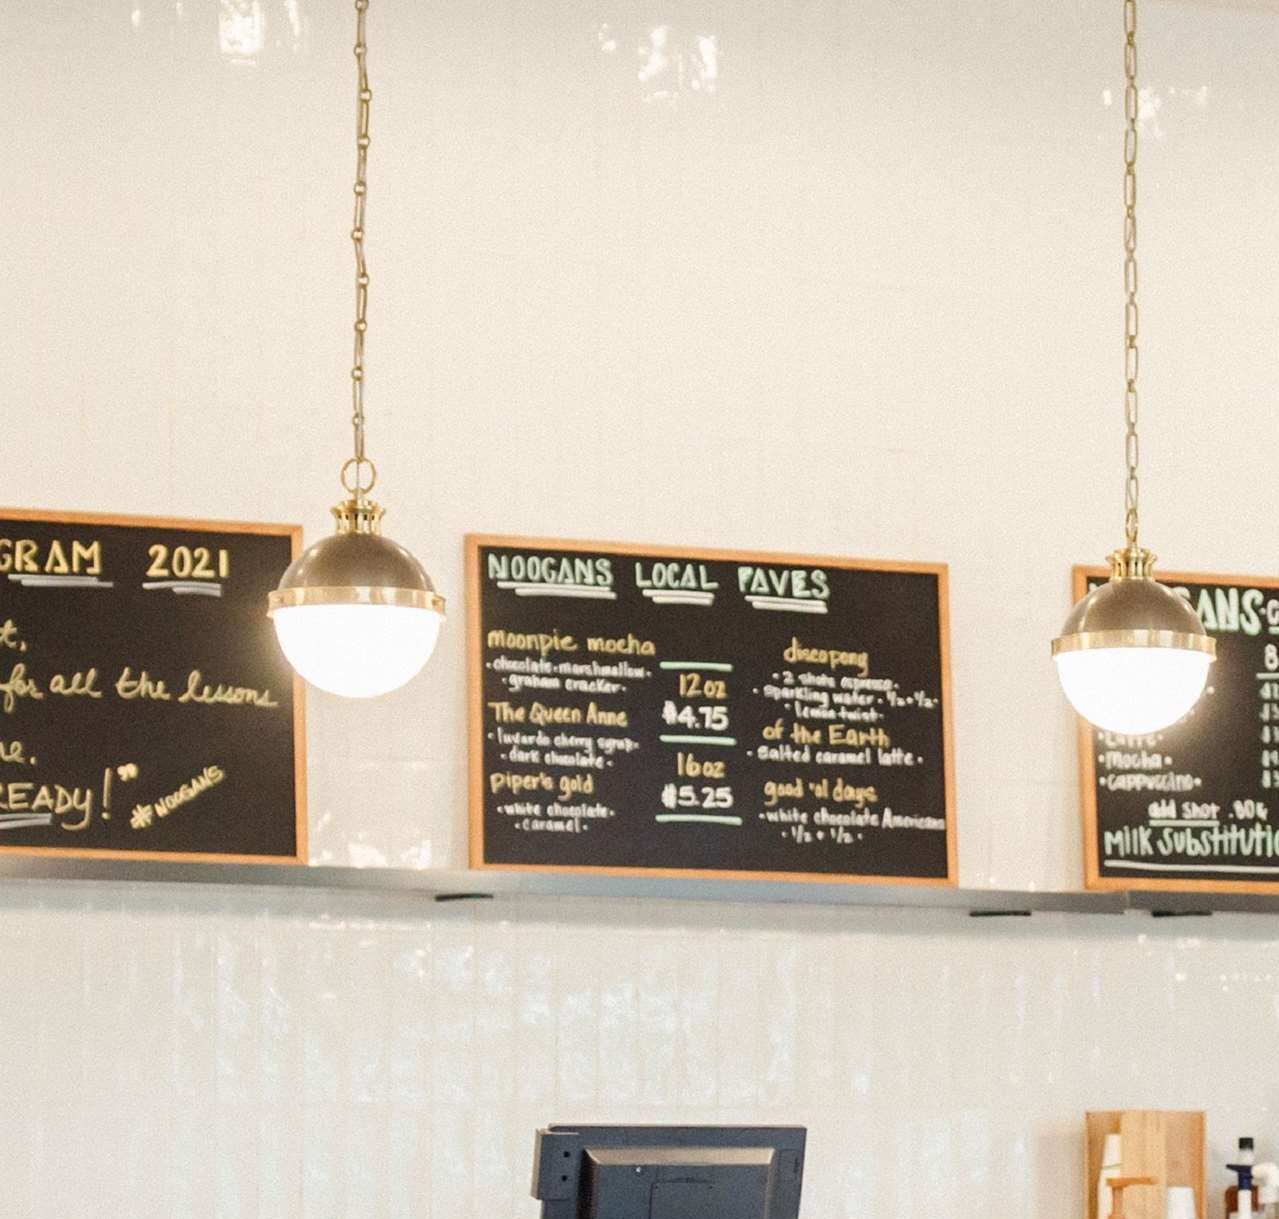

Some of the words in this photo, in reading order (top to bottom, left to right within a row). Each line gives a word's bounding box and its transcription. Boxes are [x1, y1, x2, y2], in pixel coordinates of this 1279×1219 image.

[145, 544, 230, 579] 2021
[488, 553, 615, 586] NOOGANS
[634, 562, 719, 590] LOCAL
[737, 566, 831, 599] FAVES
[487, 628, 578, 656] moonpie
[587, 633, 656, 656] mocha
[49, 667, 102, 699] all
[116, 667, 171, 702] the
[178, 670, 279, 708] lessons
[509, 673, 561, 692] graham
[564, 678, 621, 694] cracker
[782, 671, 795, 685] 2
[832, 691, 873, 706] water
[487, 701, 525, 723] The
[529, 701, 582, 726] Queen
[586, 701, 628, 727] Anne
[662, 700, 729, 731] $4.75
[554, 732, 593, 753] cherry
[762, 718, 784, 740] of
[790, 722, 821, 745] the
[829, 724, 890, 748] Earth
[509, 745, 540, 763] dark
[544, 751, 604, 770] chocolate
[816, 747, 870, 764] caramel
[878, 747, 914, 766] latte
[558, 773, 594, 801] gold
[661, 783, 734, 810] $5.25
[764, 778, 803, 806] good
[833, 778, 878, 808] days
[504, 802, 541, 816] white
[547, 802, 608, 818] chocolate
[767, 808, 808, 824] white
[814, 807, 878, 826] chocolate
[1148, 800, 1176, 819] add
[522, 818, 581, 833] caramel
[1104, 825, 1154, 857] Milk
